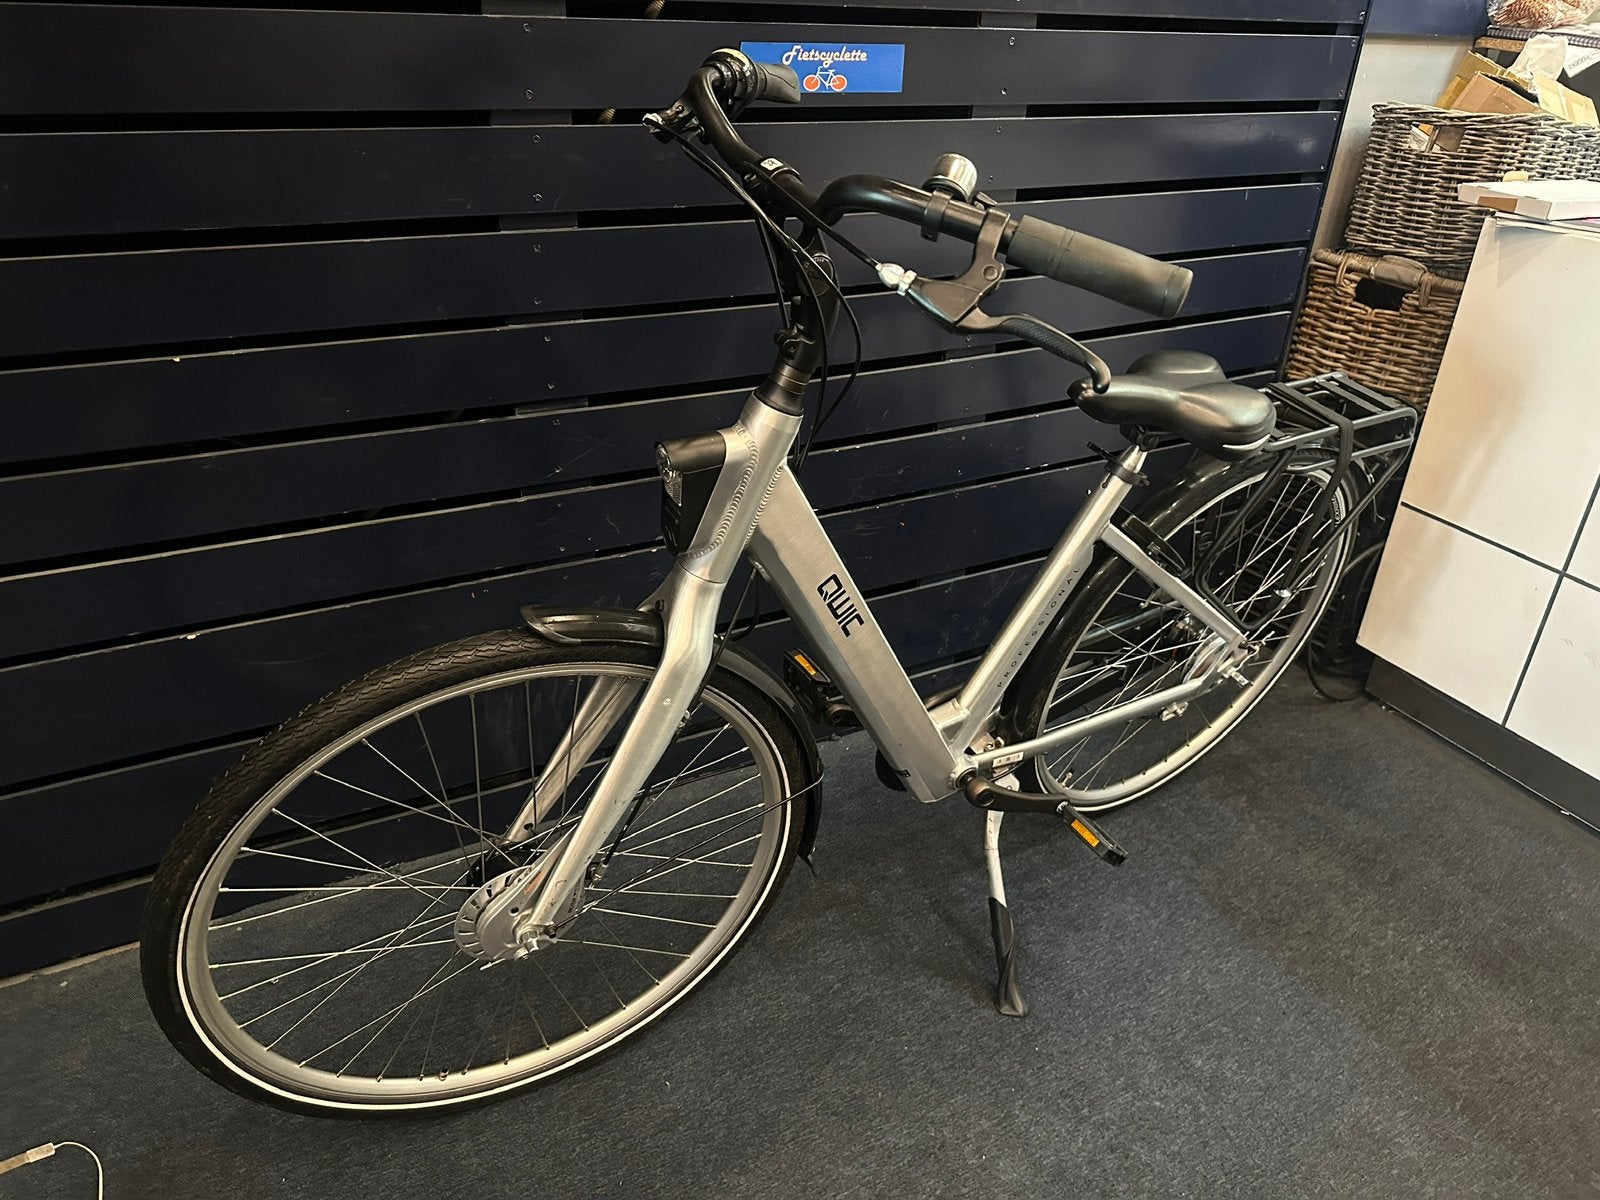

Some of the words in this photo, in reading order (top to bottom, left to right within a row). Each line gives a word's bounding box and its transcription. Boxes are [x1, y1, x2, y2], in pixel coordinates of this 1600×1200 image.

[782, 45, 868, 68] Fietscyclette
[817, 573, 865, 637] QWIC
[997, 568, 1080, 688] PROFESSIONAL
